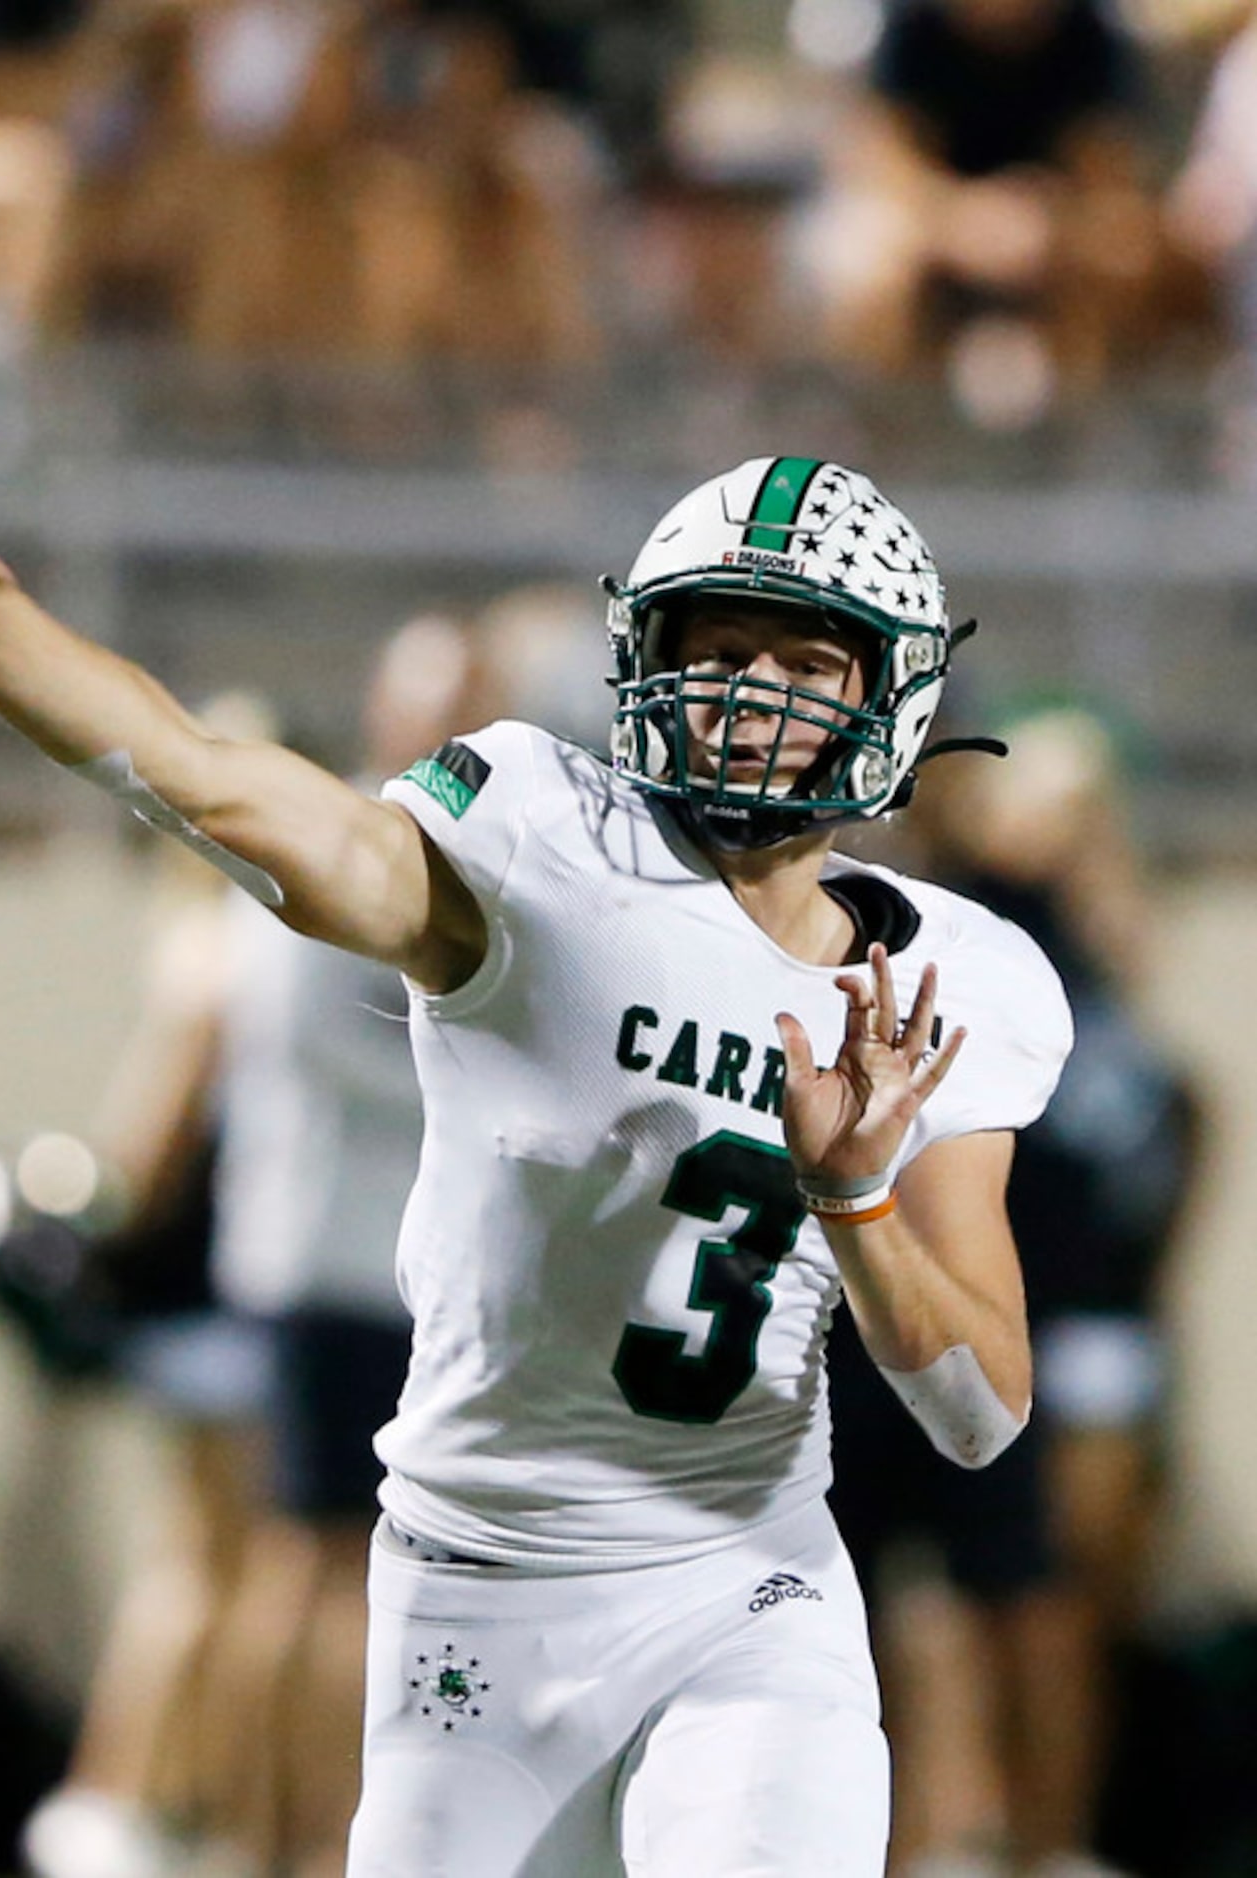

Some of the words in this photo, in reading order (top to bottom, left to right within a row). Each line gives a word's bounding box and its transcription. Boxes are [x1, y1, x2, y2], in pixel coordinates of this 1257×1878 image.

[737, 551, 796, 570] DRAGONS
[615, 1002, 826, 1120] CARR
[611, 1128, 808, 1424] 3
[748, 1584, 824, 1613] adidas
